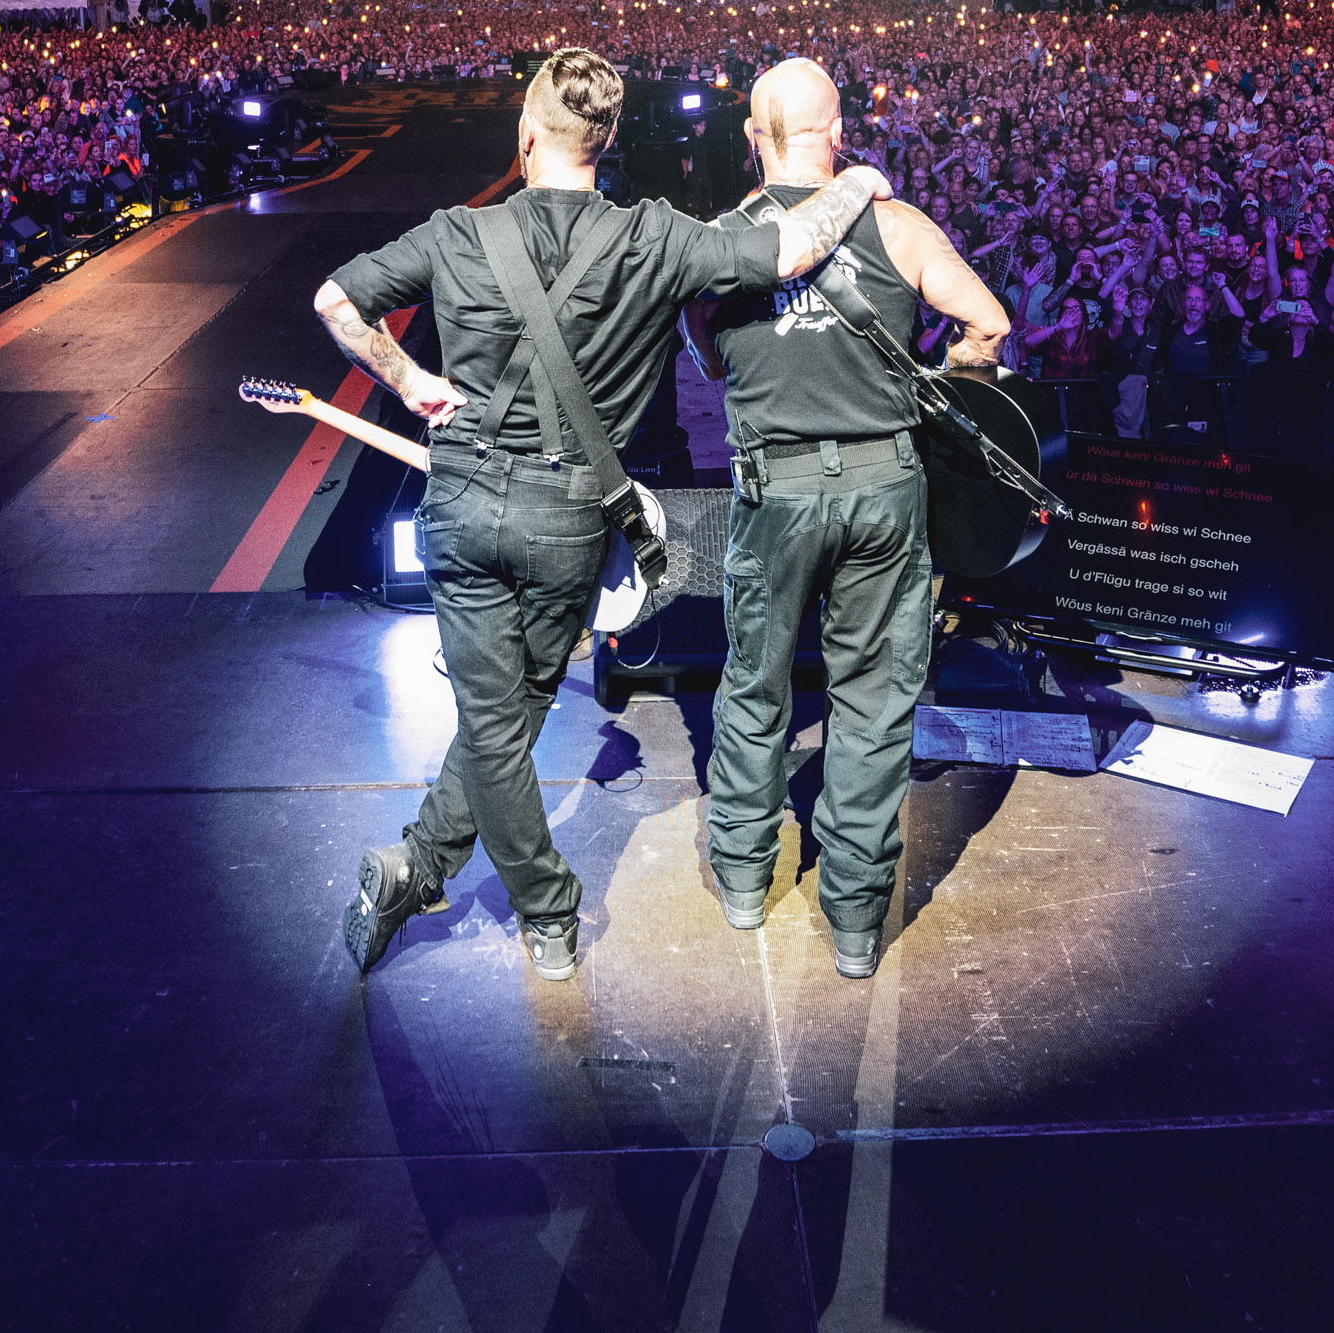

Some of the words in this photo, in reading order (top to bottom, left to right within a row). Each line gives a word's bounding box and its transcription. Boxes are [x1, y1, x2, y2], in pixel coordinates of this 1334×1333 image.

[1101, 473, 1151, 489] Schwan
[1154, 480, 1171, 491] so
[1173, 482, 1201, 495] wiss
[1205, 486, 1219, 497] wi
[1222, 487, 1274, 504] Schnee
[1077, 511, 1128, 528] Schwan
[1131, 521, 1148, 531] so
[1150, 522, 1179, 535] wiss
[1183, 525, 1197, 537] wi
[1200, 527, 1252, 544] Schnee
[1067, 538, 1127, 557] Vergässä
[1130, 549, 1156, 561] was
[1160, 551, 1187, 565] isch
[1189, 555, 1240, 572] gscheh
[1069, 567, 1080, 580] U
[1134, 577, 1169, 594] trage
[1172, 583, 1184, 595] si
[1187, 586, 1204, 598] so
[1208, 588, 1228, 601] wit
[1055, 596, 1093, 612] Wöus
[1095, 601, 1124, 617] keni
[1127, 607, 1177, 625] Gränze
[1180, 615, 1211, 631] meh
[1214, 621, 1232, 634] git
